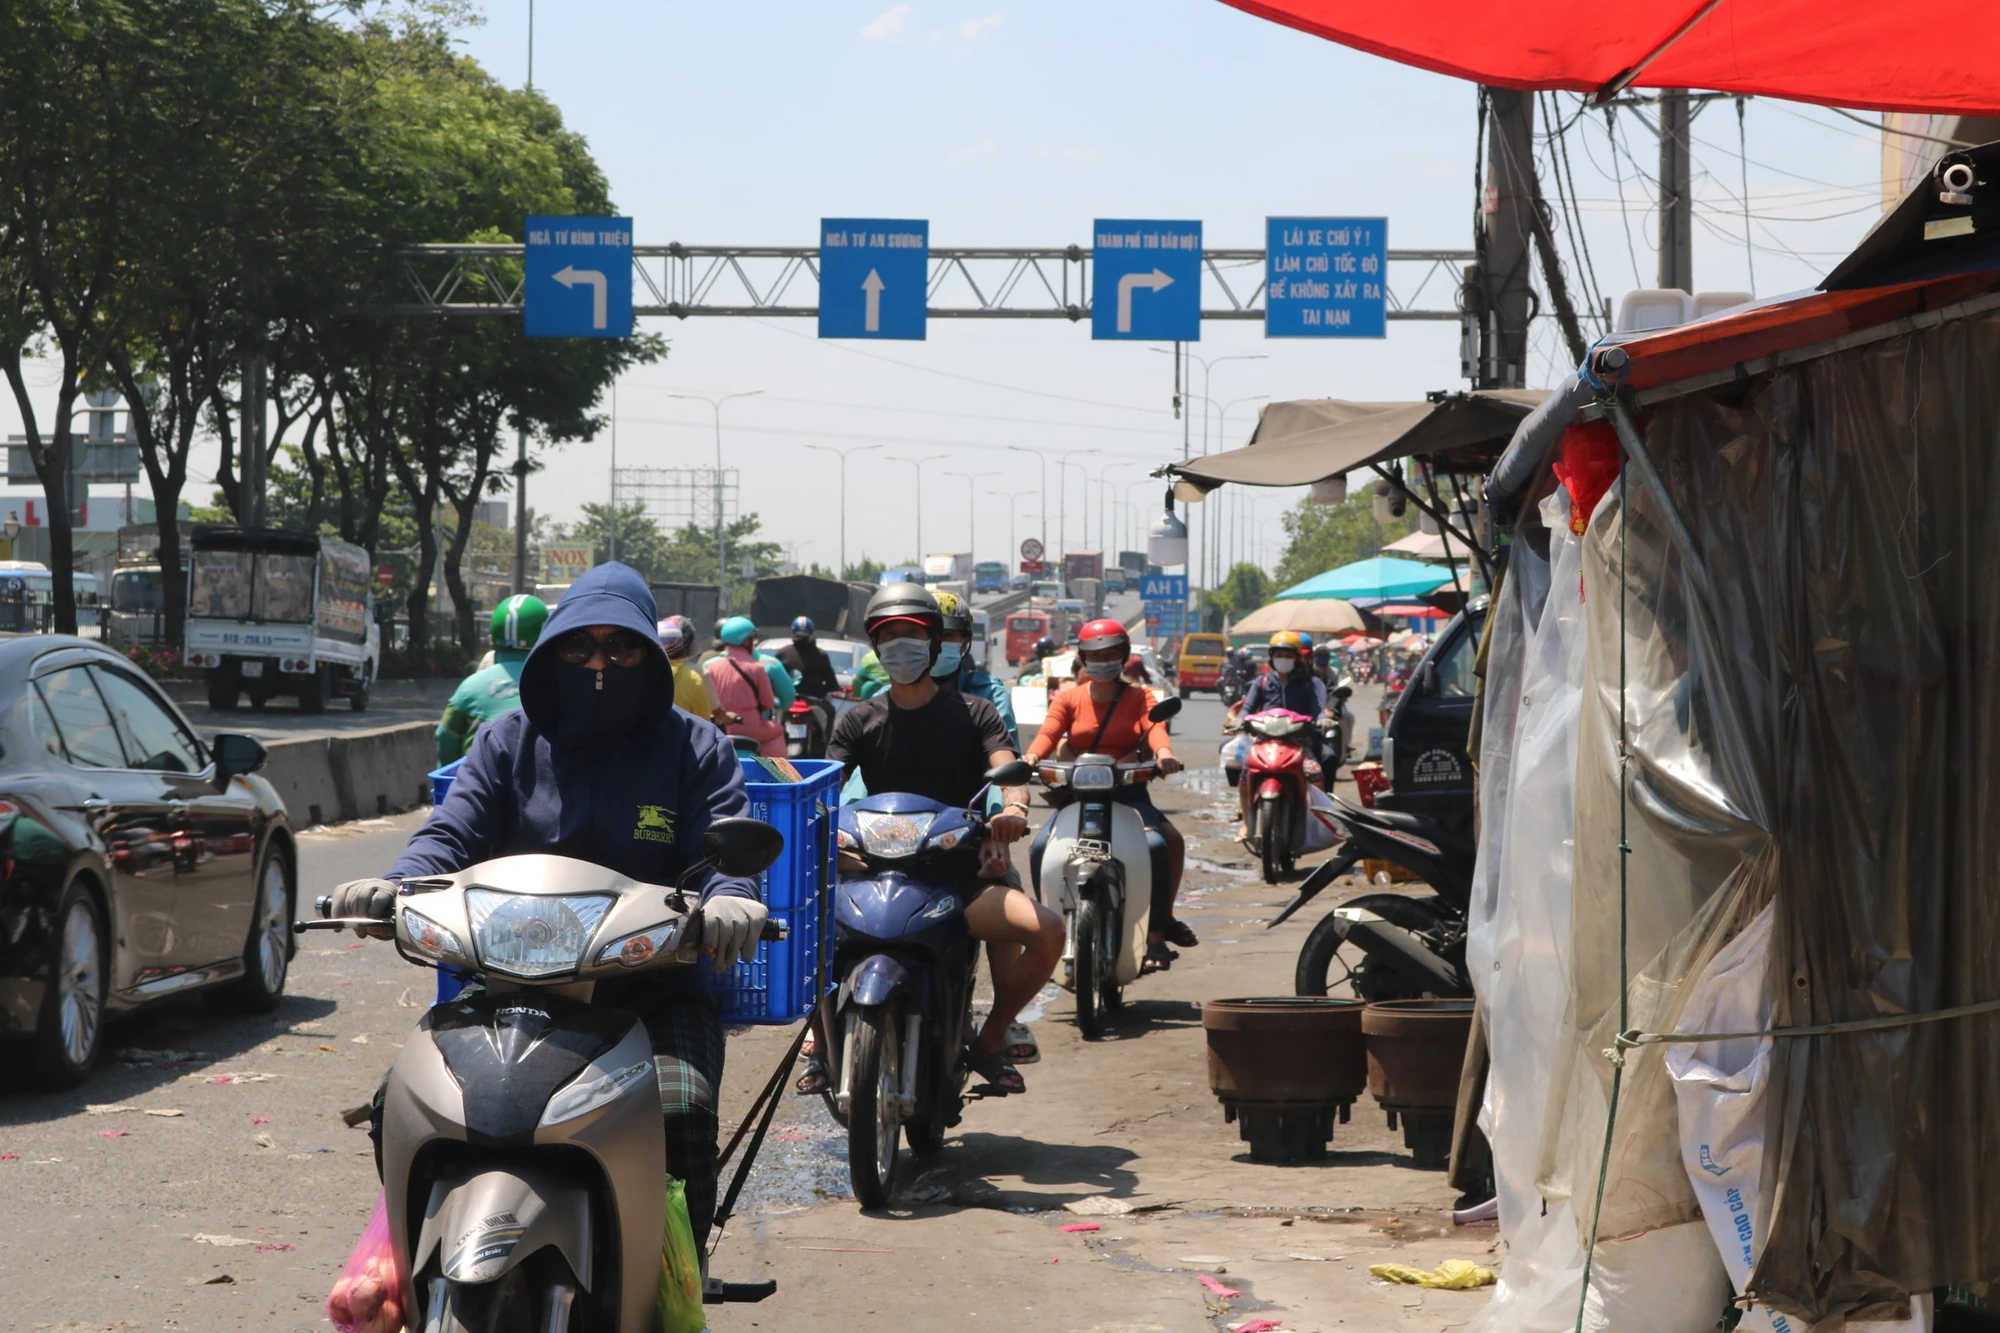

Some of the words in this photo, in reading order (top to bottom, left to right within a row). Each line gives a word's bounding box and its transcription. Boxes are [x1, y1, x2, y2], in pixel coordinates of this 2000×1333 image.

[869, 233, 885, 248] AN
[1307, 229, 1323, 247] XE
[1326, 226, 1350, 247] CHÚ
[1274, 252, 1300, 273] LÀM
[1334, 251, 1357, 273] TỐC
[1361, 253, 1379, 276] ĐỘ
[1290, 279, 1330, 299] KHÔNG
[1363, 283, 1381, 299] RA
[1302, 308, 1321, 325] TAI
[1325, 308, 1351, 329] NẠN
[1145, 580, 1171, 595] AH
[1175, 580, 1184, 595] 1
[495, 1006, 551, 1019] HONDA
[1734, 1213, 1753, 1242] CAO
